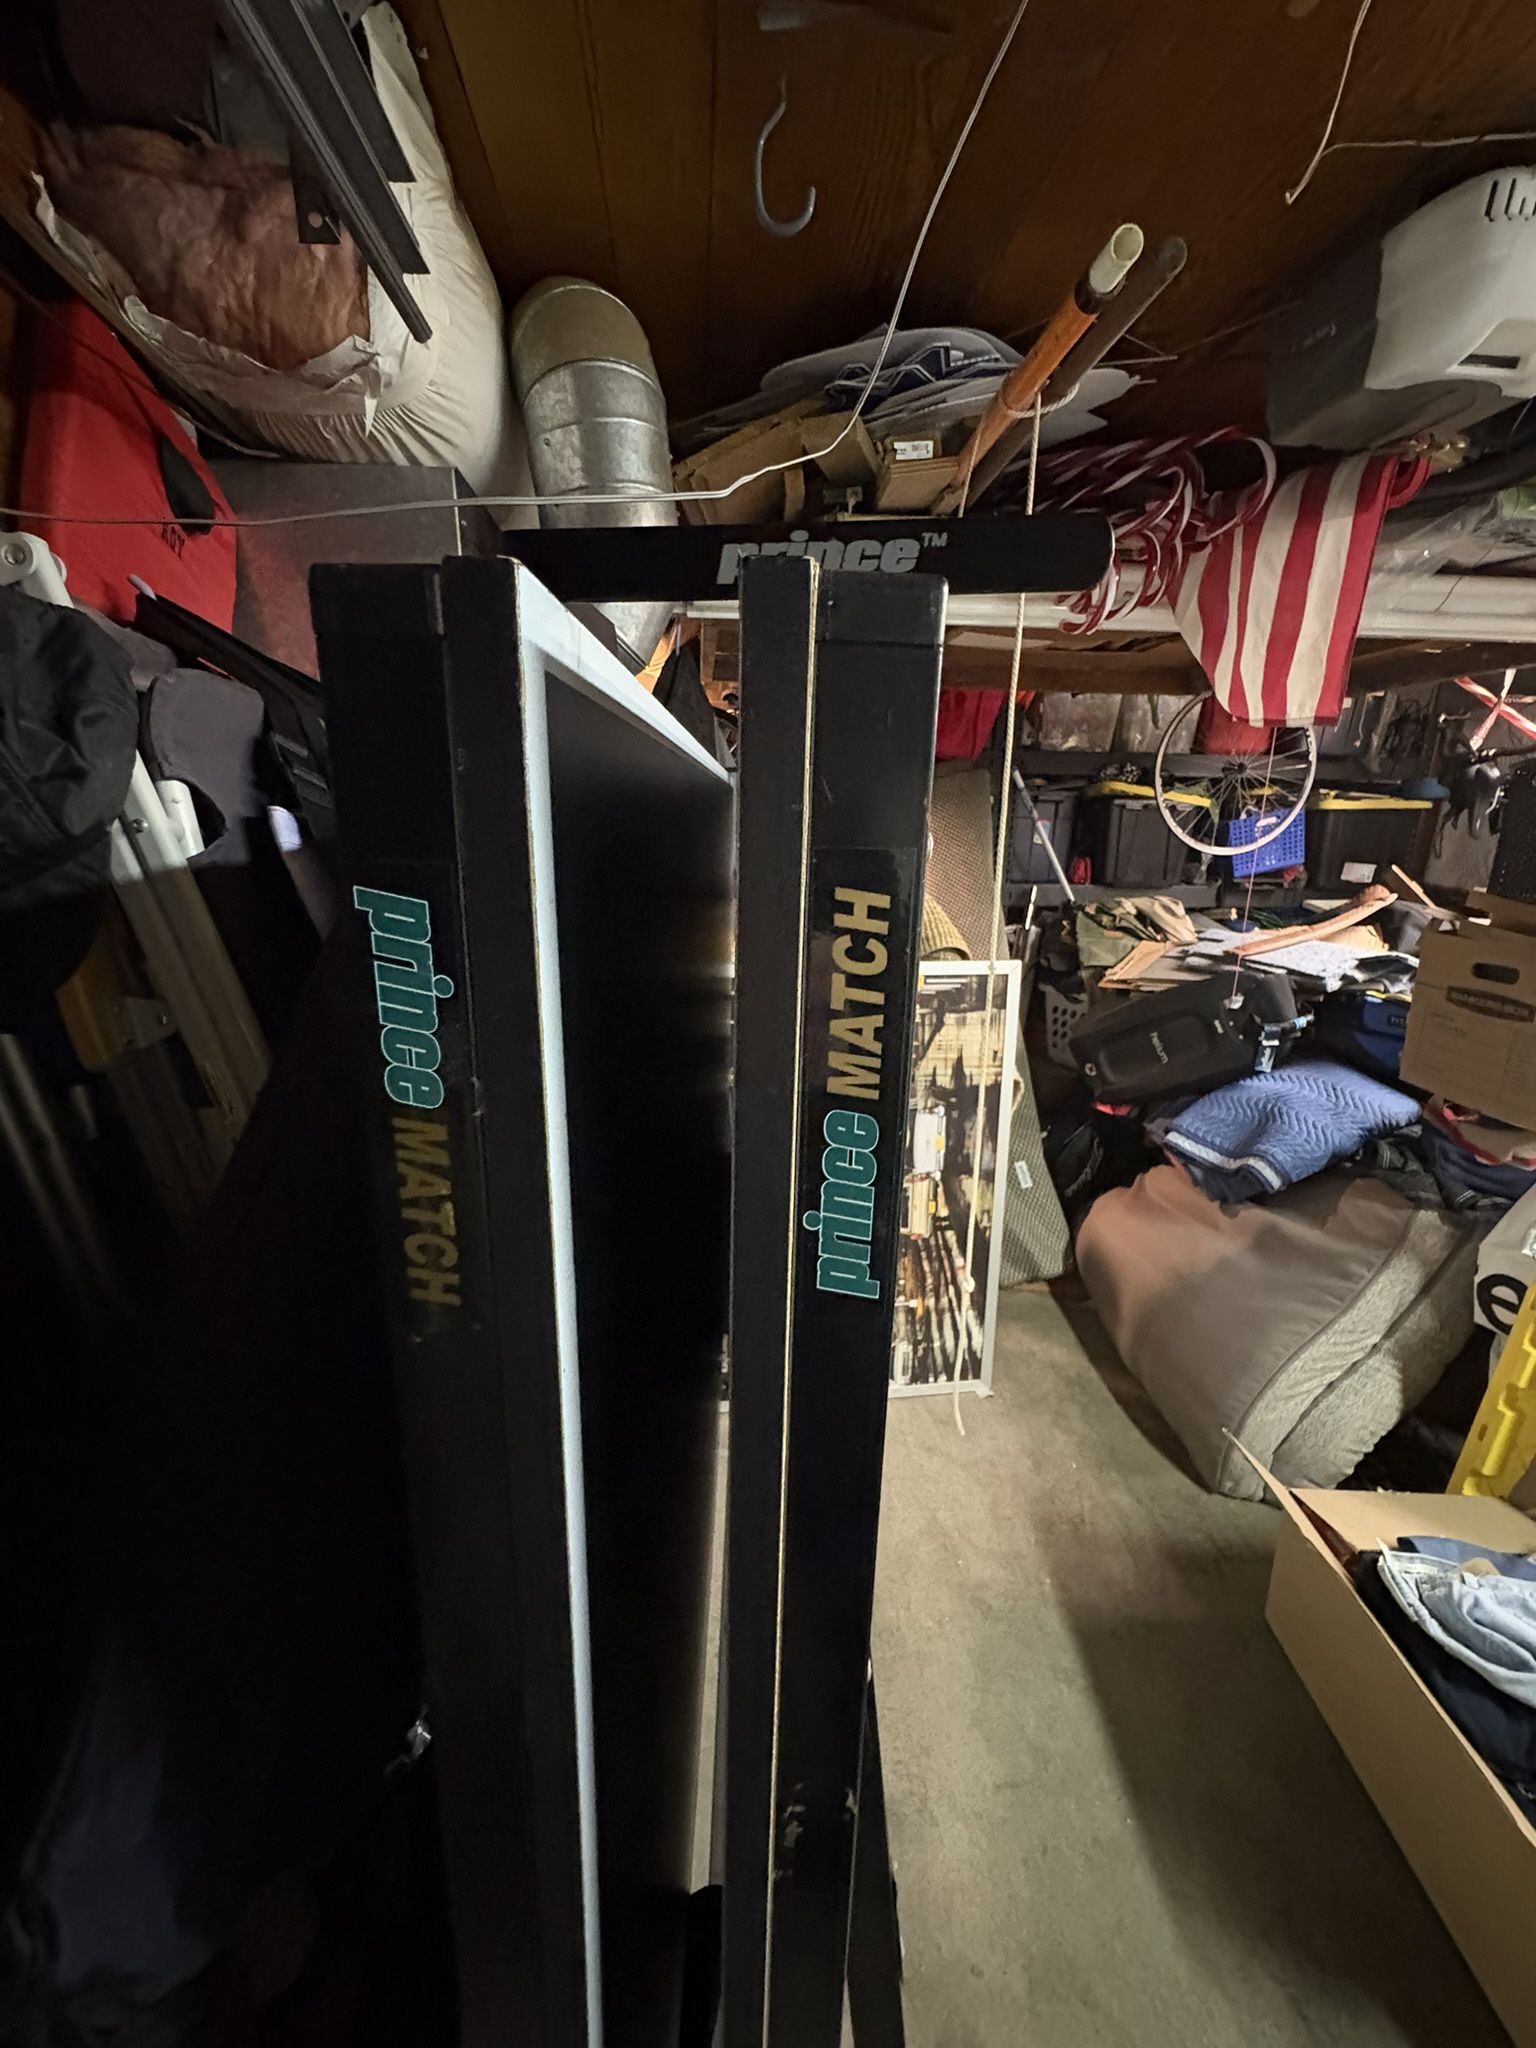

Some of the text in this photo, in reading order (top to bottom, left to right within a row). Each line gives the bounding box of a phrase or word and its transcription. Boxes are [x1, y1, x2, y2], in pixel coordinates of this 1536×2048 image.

[353, 885, 461, 1307] prince MATCH
[803, 886, 891, 1299] prince MATCH
